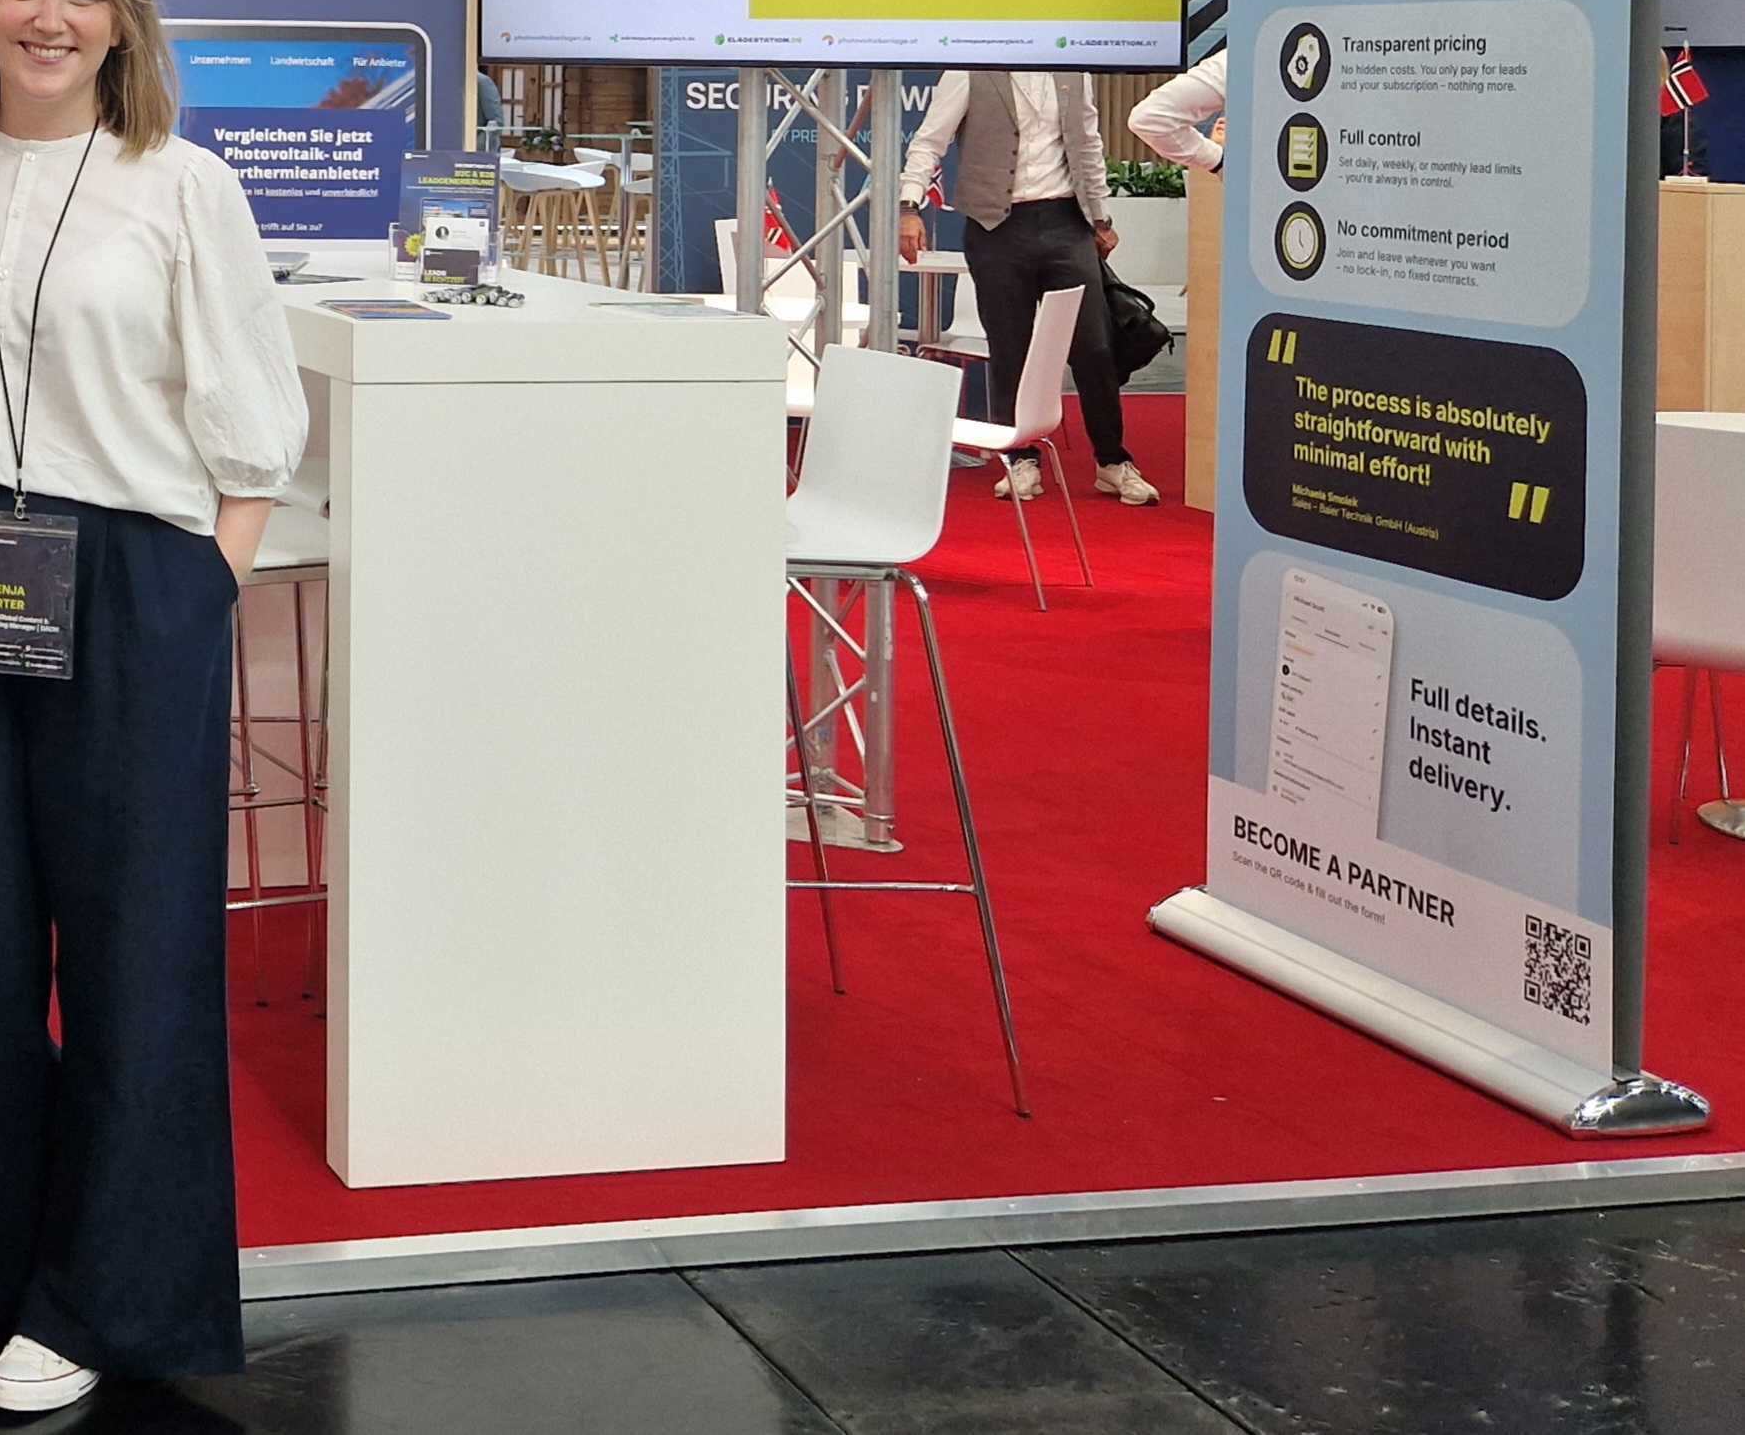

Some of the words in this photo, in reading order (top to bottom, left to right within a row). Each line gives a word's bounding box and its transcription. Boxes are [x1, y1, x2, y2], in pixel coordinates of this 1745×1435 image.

[1342, 35, 1431, 58] Transparent
[1433, 35, 1487, 57] pricing
[189, 55, 252, 66] Unternehmen
[269, 56, 335, 67] Landwirtschaft
[353, 57, 367, 67] Für
[369, 58, 407, 68] Anbieter
[1341, 65, 1354, 75] No
[1356, 64, 1387, 75] hidden
[1420, 65, 1437, 75] You
[1460, 67, 1479, 78] pay
[1481, 64, 1495, 75] for
[1499, 64, 1528, 76] leads
[1359, 82, 1380, 93] your
[1383, 80, 1438, 93] subscription
[1447, 80, 1485, 94] nothing
[213, 128, 307, 145] Vergleichen
[310, 129, 334, 143] Sie
[335, 129, 373, 146] jetzt
[1339, 129, 1364, 146] Full
[1368, 130, 1421, 148] control
[224, 147, 330, 161] Photovoltaik-
[333, 147, 363, 162] und
[1469, 162, 1492, 174] lead
[1494, 163, 1522, 175] limits
[264, 187, 304, 197] kostenlos
[305, 188, 320, 196] und
[1337, 219, 1357, 237] No
[1361, 223, 1452, 245] commitment
[1455, 231, 1509, 252] period
[1357, 249, 1375, 261] and
[1377, 251, 1402, 263] leave
[1404, 253, 1448, 267] whenever
[1450, 258, 1468, 271] you
[1470, 260, 1496, 272] want
[1295, 375, 1327, 401] The
[1331, 385, 1411, 417] process
[1415, 394, 1432, 419] is
[1435, 399, 1551, 444] absolutely
[1293, 411, 1441, 455] straightforward
[1444, 436, 1492, 465] with
[1293, 441, 1365, 473] minimal
[1369, 454, 1432, 487] effort!
[1409, 677, 1450, 714] Full
[1455, 693, 1548, 743] details.
[1409, 716, 1492, 766] Instant
[1408, 756, 1513, 813] delivery.
[1233, 814, 1321, 872] BECOME
[1326, 853, 1342, 881] A
[1348, 861, 1455, 928] PARTNER
[1269, 867, 1283, 881] QR
